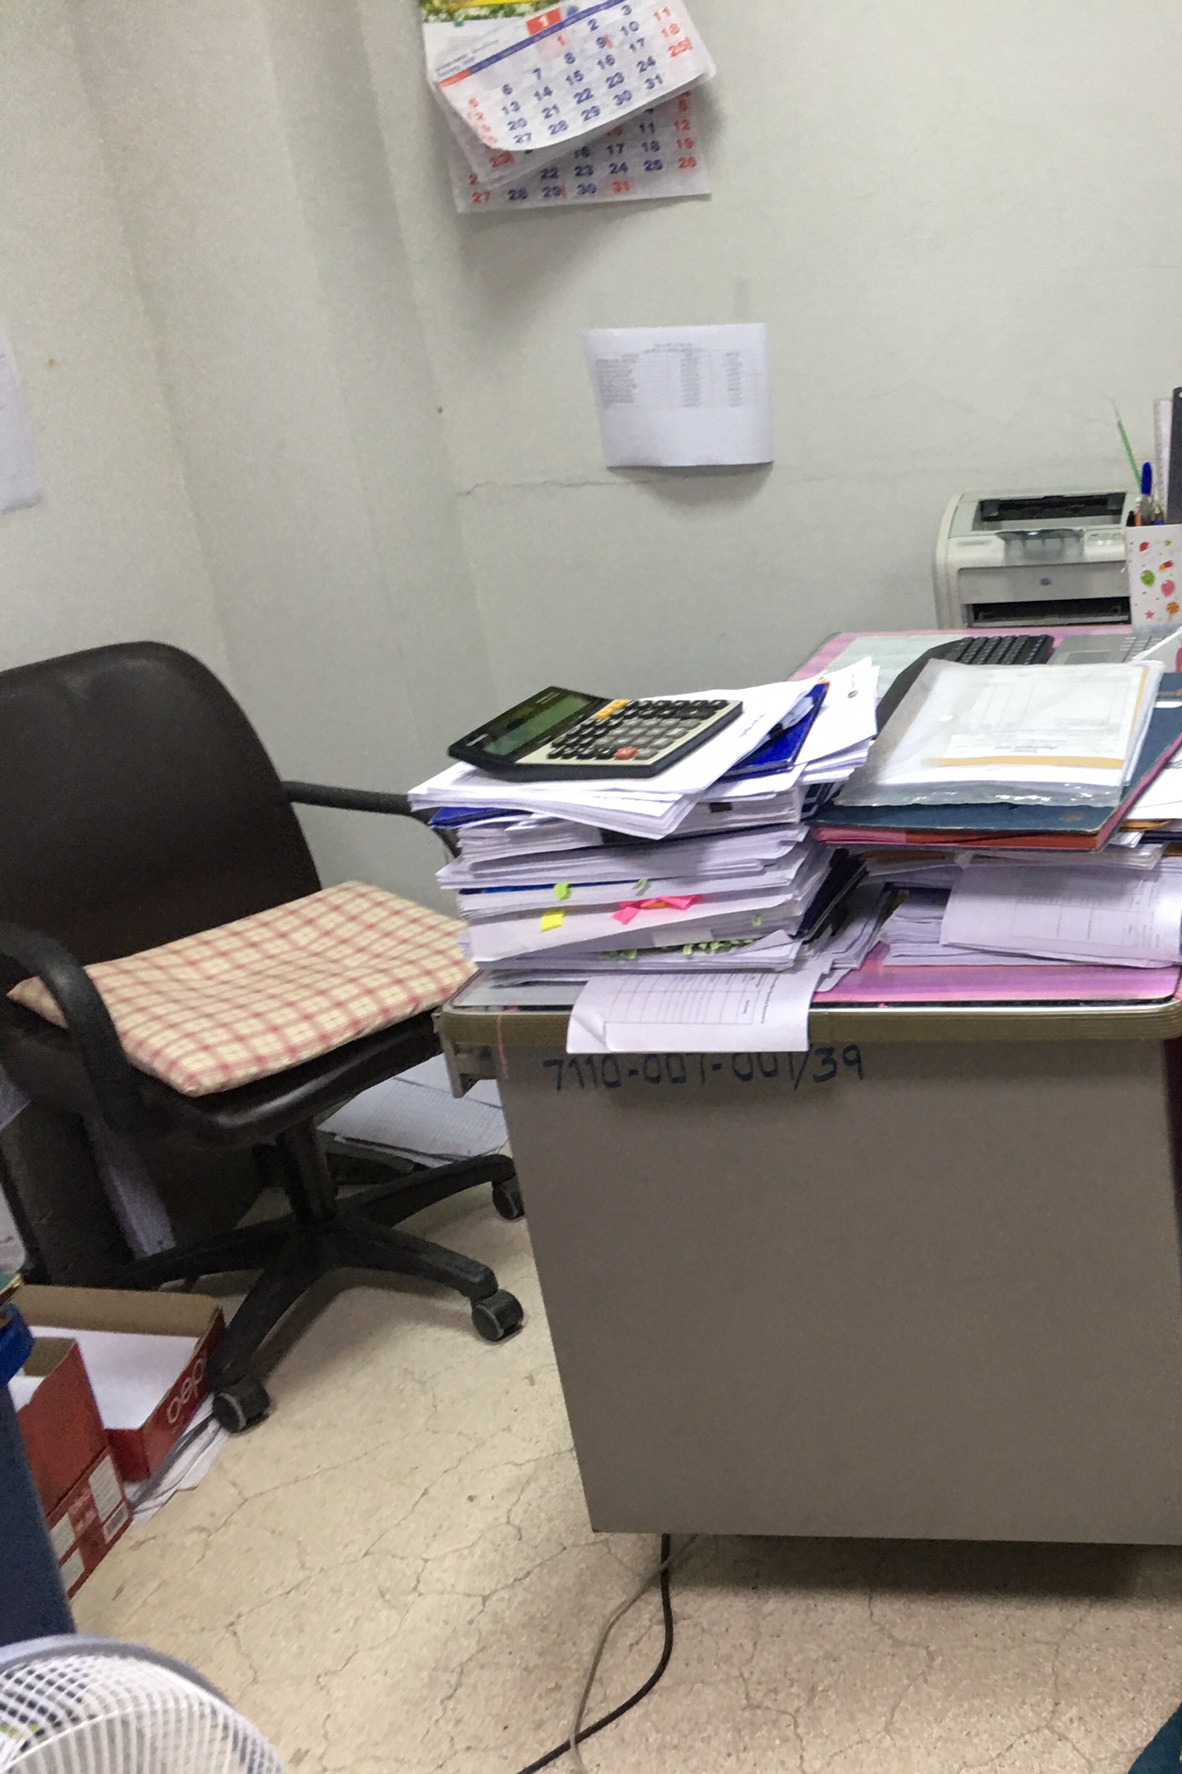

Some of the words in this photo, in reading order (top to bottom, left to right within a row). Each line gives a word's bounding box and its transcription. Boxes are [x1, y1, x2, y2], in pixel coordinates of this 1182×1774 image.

[556, 35, 566, 46] 1
[587, 18, 600, 32] 2
[621, 4, 633, 16] 3
[501, 101, 521, 116] 13
[534, 85, 553, 101] 14
[565, 69, 584, 87] 15
[597, 54, 616, 70] 16
[629, 37, 646, 53] 17
[661, 23, 681, 38] 18
[502, 83, 513, 96] 6
[532, 67, 542, 80] 7
[563, 52, 576, 65] 8
[620, 20, 640, 36] 10
[653, 6, 672, 22] 11
[507, 117, 528, 132] 20
[541, 104, 560, 119] 21
[573, 87, 595, 105] 22
[605, 72, 625, 90] 23
[636, 55, 657, 74] 24
[512, 132, 533, 144] 27
[548, 119, 569, 136] 28
[580, 105, 601, 122] 29
[612, 89, 633, 106] 30
[644, 73, 664, 90] 31
[605, 141, 626, 156] 17
[641, 139, 661, 153] 18
[676, 137, 695, 150] 19
[638, 121, 656, 135] 11
[673, 118, 692, 132] 12
[540, 166, 560, 180] 22
[573, 164, 595, 178] 23
[608, 161, 629, 175] 24
[643, 158, 664, 172] 25
[677, 155, 698, 170] 26
[471, 190, 491, 204] 27
[576, 182, 598, 196] 30
[611, 180, 631, 194] 31
